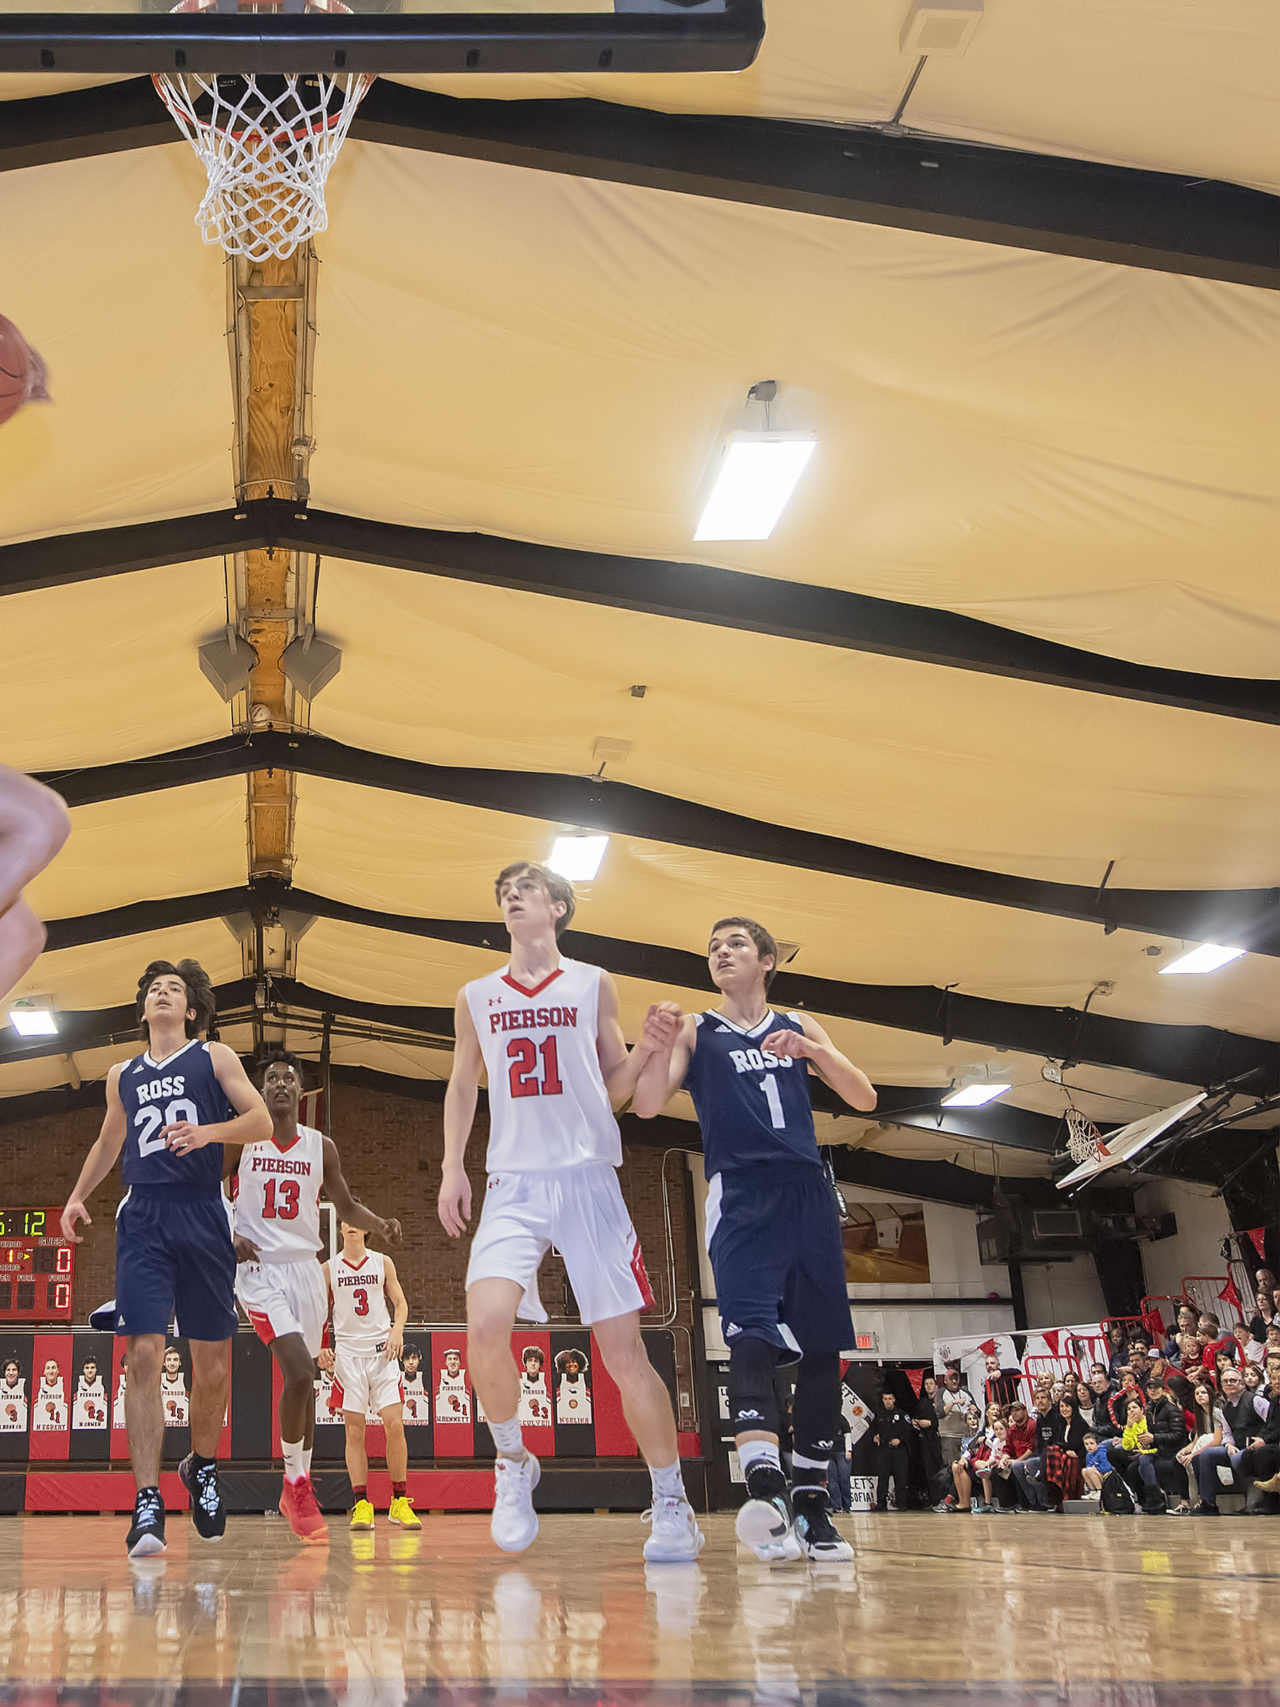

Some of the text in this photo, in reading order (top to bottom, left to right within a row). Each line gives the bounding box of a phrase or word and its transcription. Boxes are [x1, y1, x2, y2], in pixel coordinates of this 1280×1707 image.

[489, 1007, 578, 1035] PIERSON
[507, 1035, 563, 1098] 21
[728, 1048, 793, 1074] ROSS
[136, 1075, 185, 1105] ROSS
[759, 1073, 786, 1128] 1
[134, 1098, 199, 1158] 20
[252, 1157, 311, 1176] PIERSON
[262, 1178, 300, 1220] 13
[8, 1249, 14, 1263] 1
[56, 1249, 71, 1272] 0
[338, 1275, 378, 1287] PIERSON
[55, 1284, 70, 1308] 0
[353, 1288, 369, 1316] 3
[842, 1385, 859, 1405] ET'S
[453, 1400, 467, 1416] 21
[532, 1406, 548, 1419] 23
